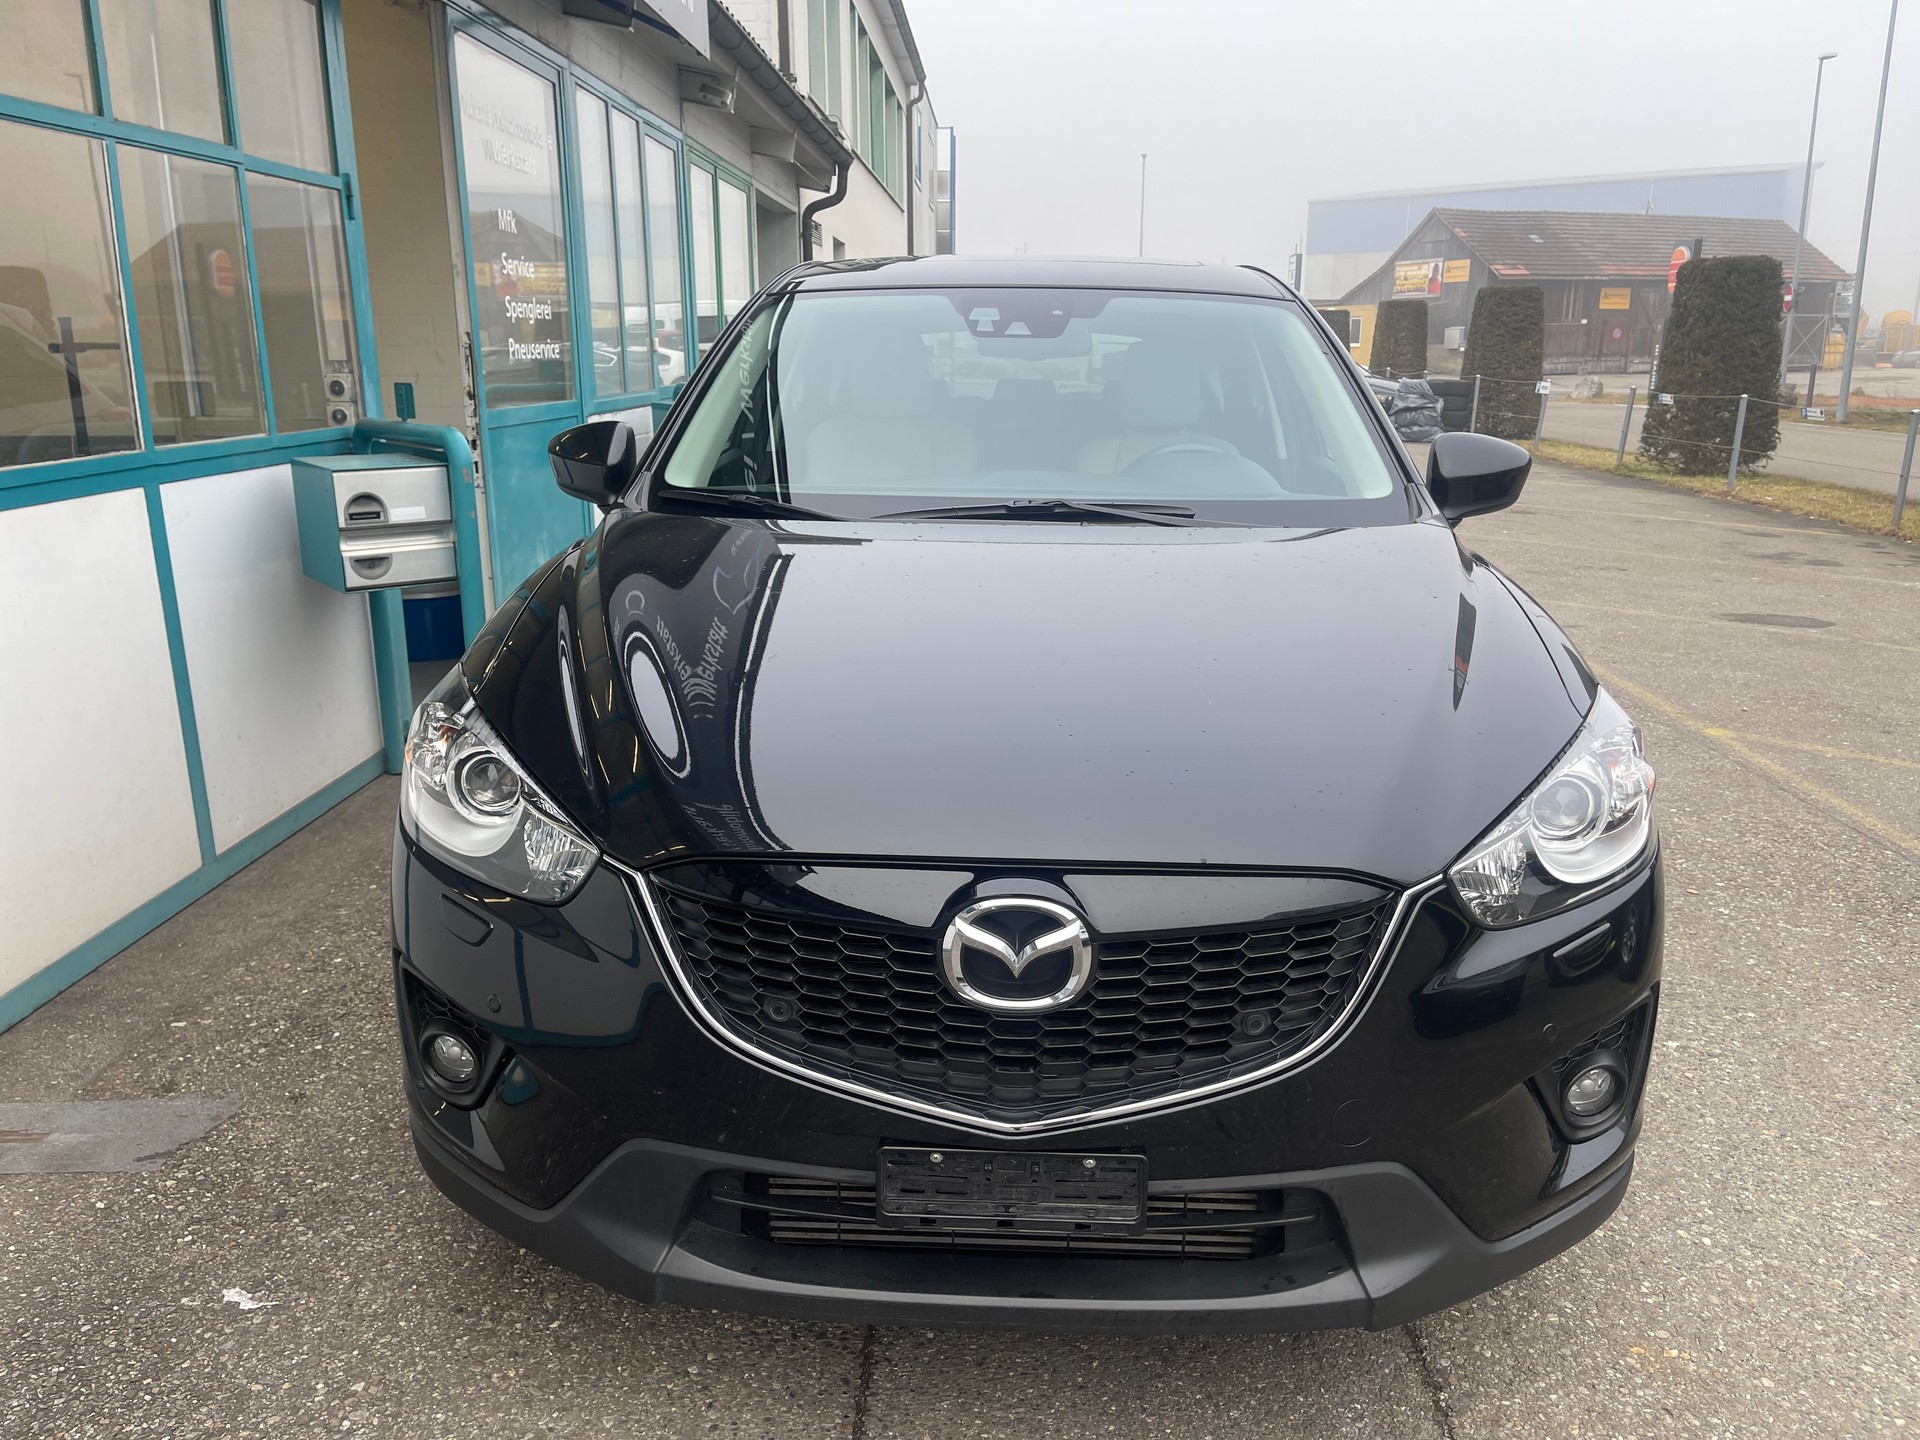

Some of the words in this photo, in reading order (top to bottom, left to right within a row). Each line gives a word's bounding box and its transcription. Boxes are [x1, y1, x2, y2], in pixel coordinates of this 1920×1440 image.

[498, 208, 517, 234] Mfk
[501, 252, 535, 278] Service
[505, 295, 552, 325] Spenglerei
[508, 338, 560, 361] Pneuservice
